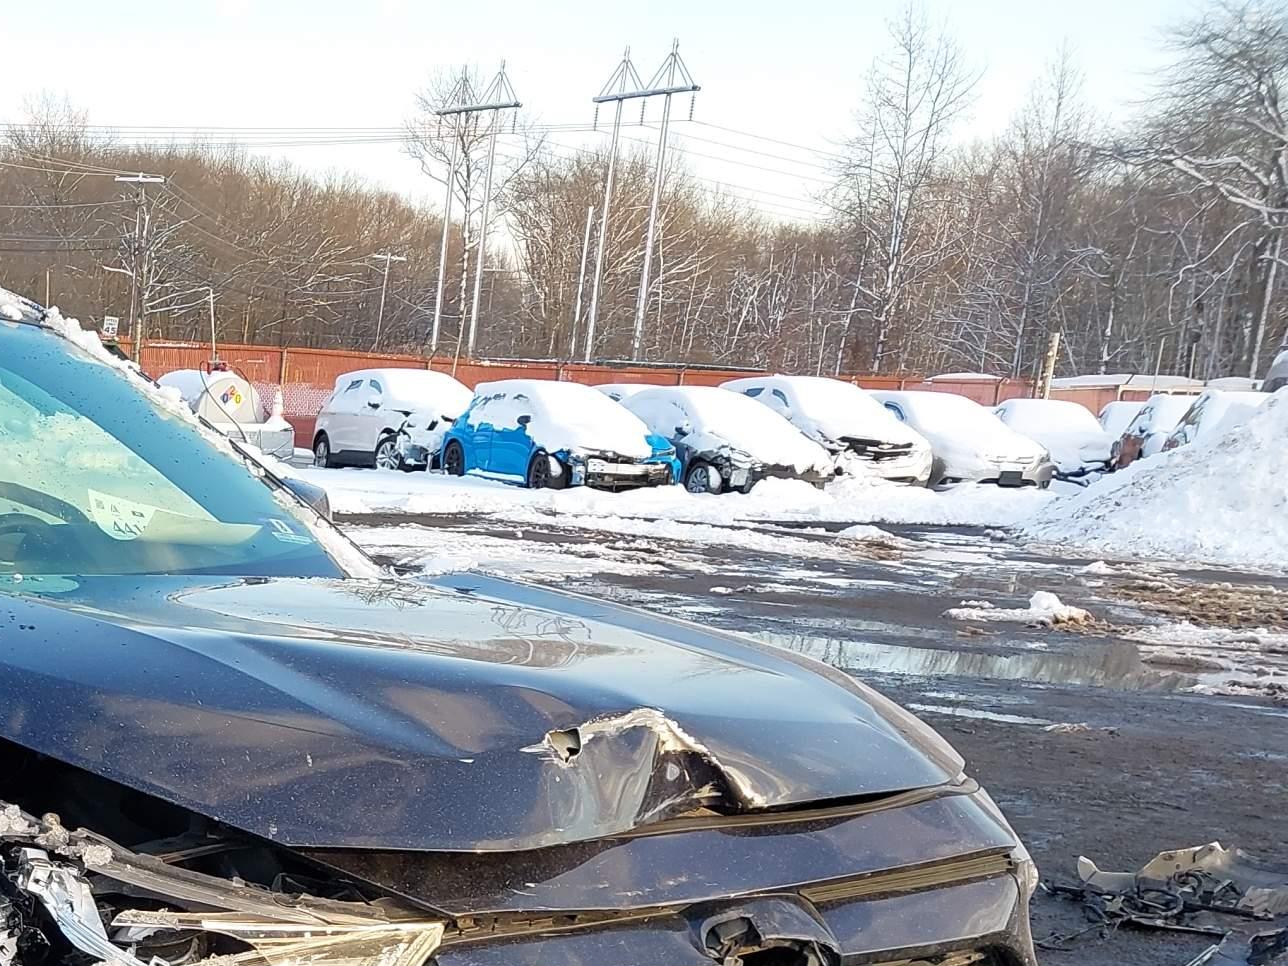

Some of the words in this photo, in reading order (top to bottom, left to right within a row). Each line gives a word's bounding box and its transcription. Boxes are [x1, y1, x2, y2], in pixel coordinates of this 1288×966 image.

[104, 326, 116, 334] 45
[230, 385, 236, 396] 2
[222, 393, 228, 404] 0
[235, 394, 241, 404] 0
